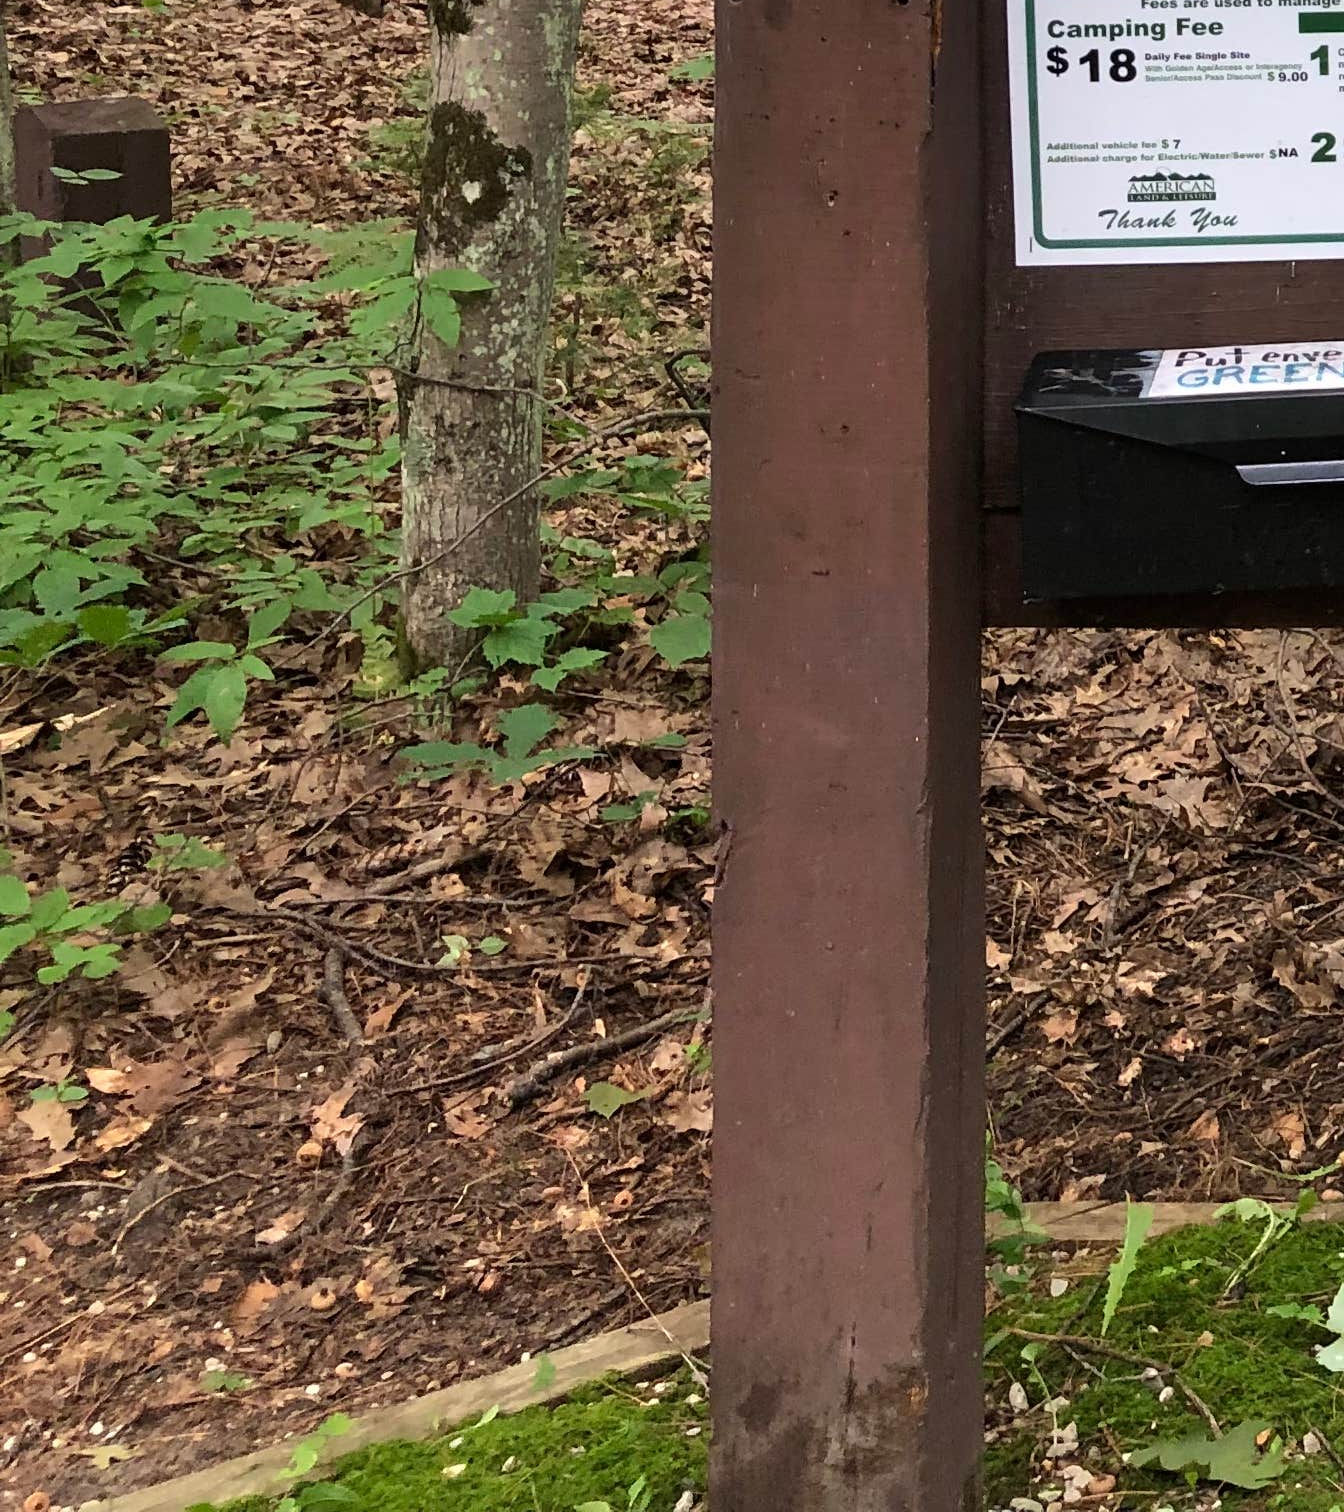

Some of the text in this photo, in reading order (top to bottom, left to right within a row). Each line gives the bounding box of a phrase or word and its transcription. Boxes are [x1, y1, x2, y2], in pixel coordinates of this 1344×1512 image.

[1047, 18, 1223, 41] Camping Fee
[1310, 45, 1329, 75] 1
[1311, 132, 1336, 162] 2
[1129, 180, 1215, 193] AMERICAN
[1098, 207, 1238, 233] Thank You
[1176, 348, 1248, 367] Put
